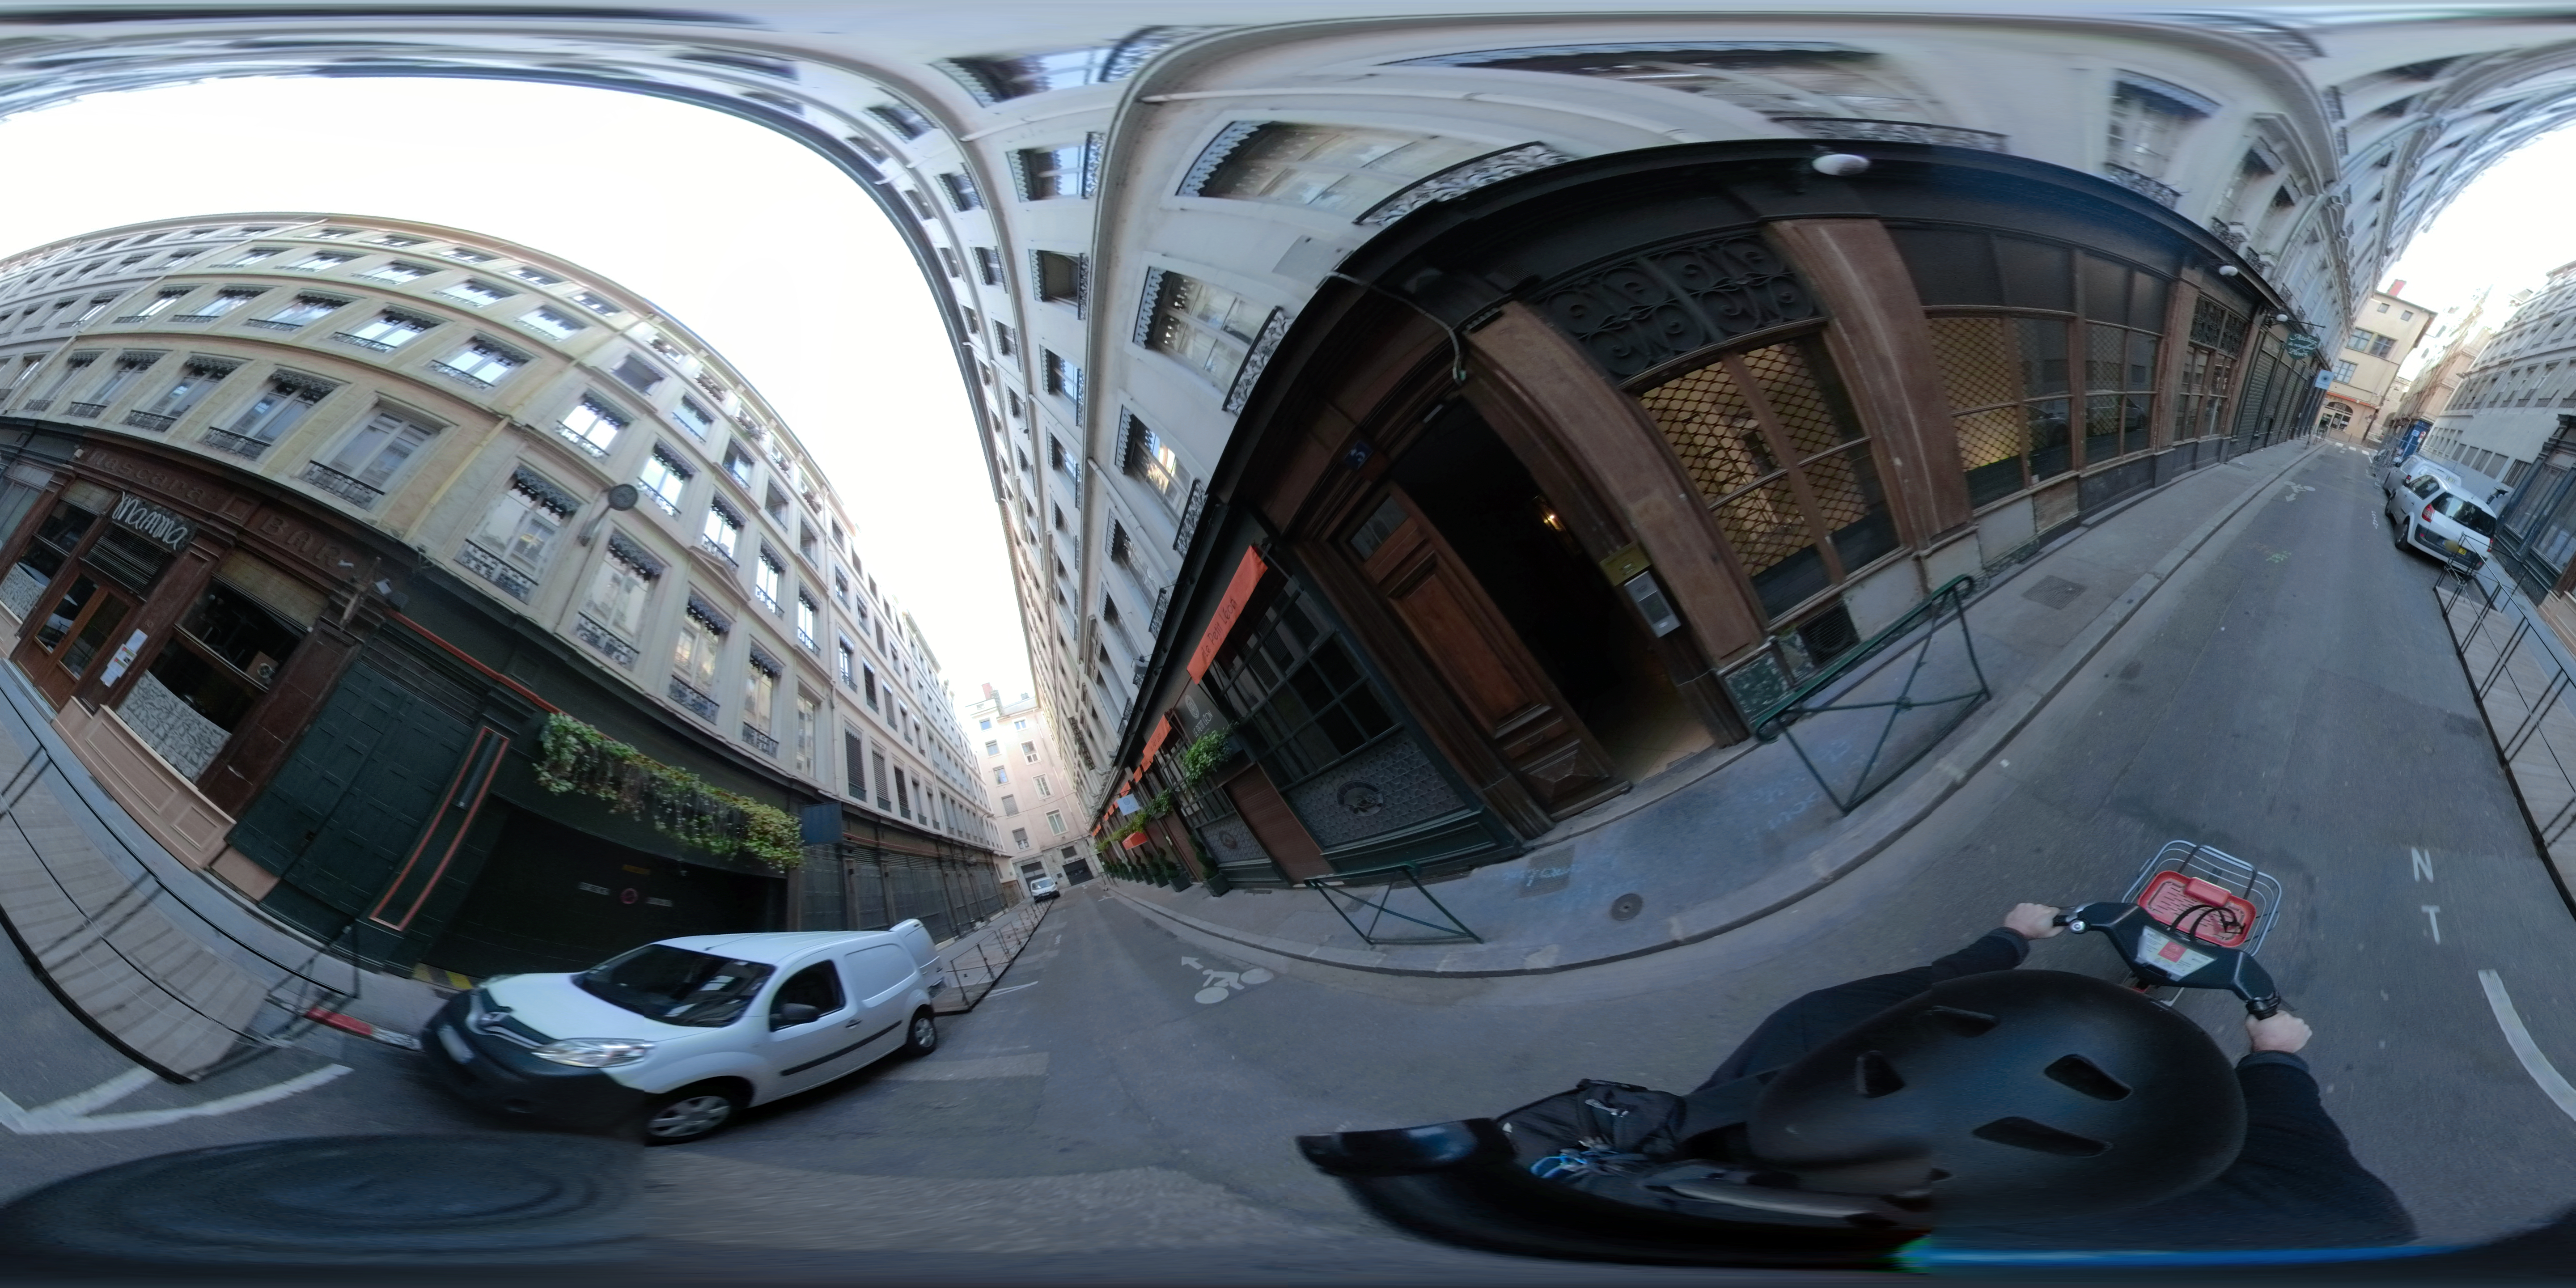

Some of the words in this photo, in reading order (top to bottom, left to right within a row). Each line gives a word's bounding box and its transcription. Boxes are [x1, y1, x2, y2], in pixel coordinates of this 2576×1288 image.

[90, 450, 203, 501] Mascara
[260, 515, 341, 568] BAR
[1207, 623, 1223, 646] Petit
[1219, 599, 1237, 624] Léon
